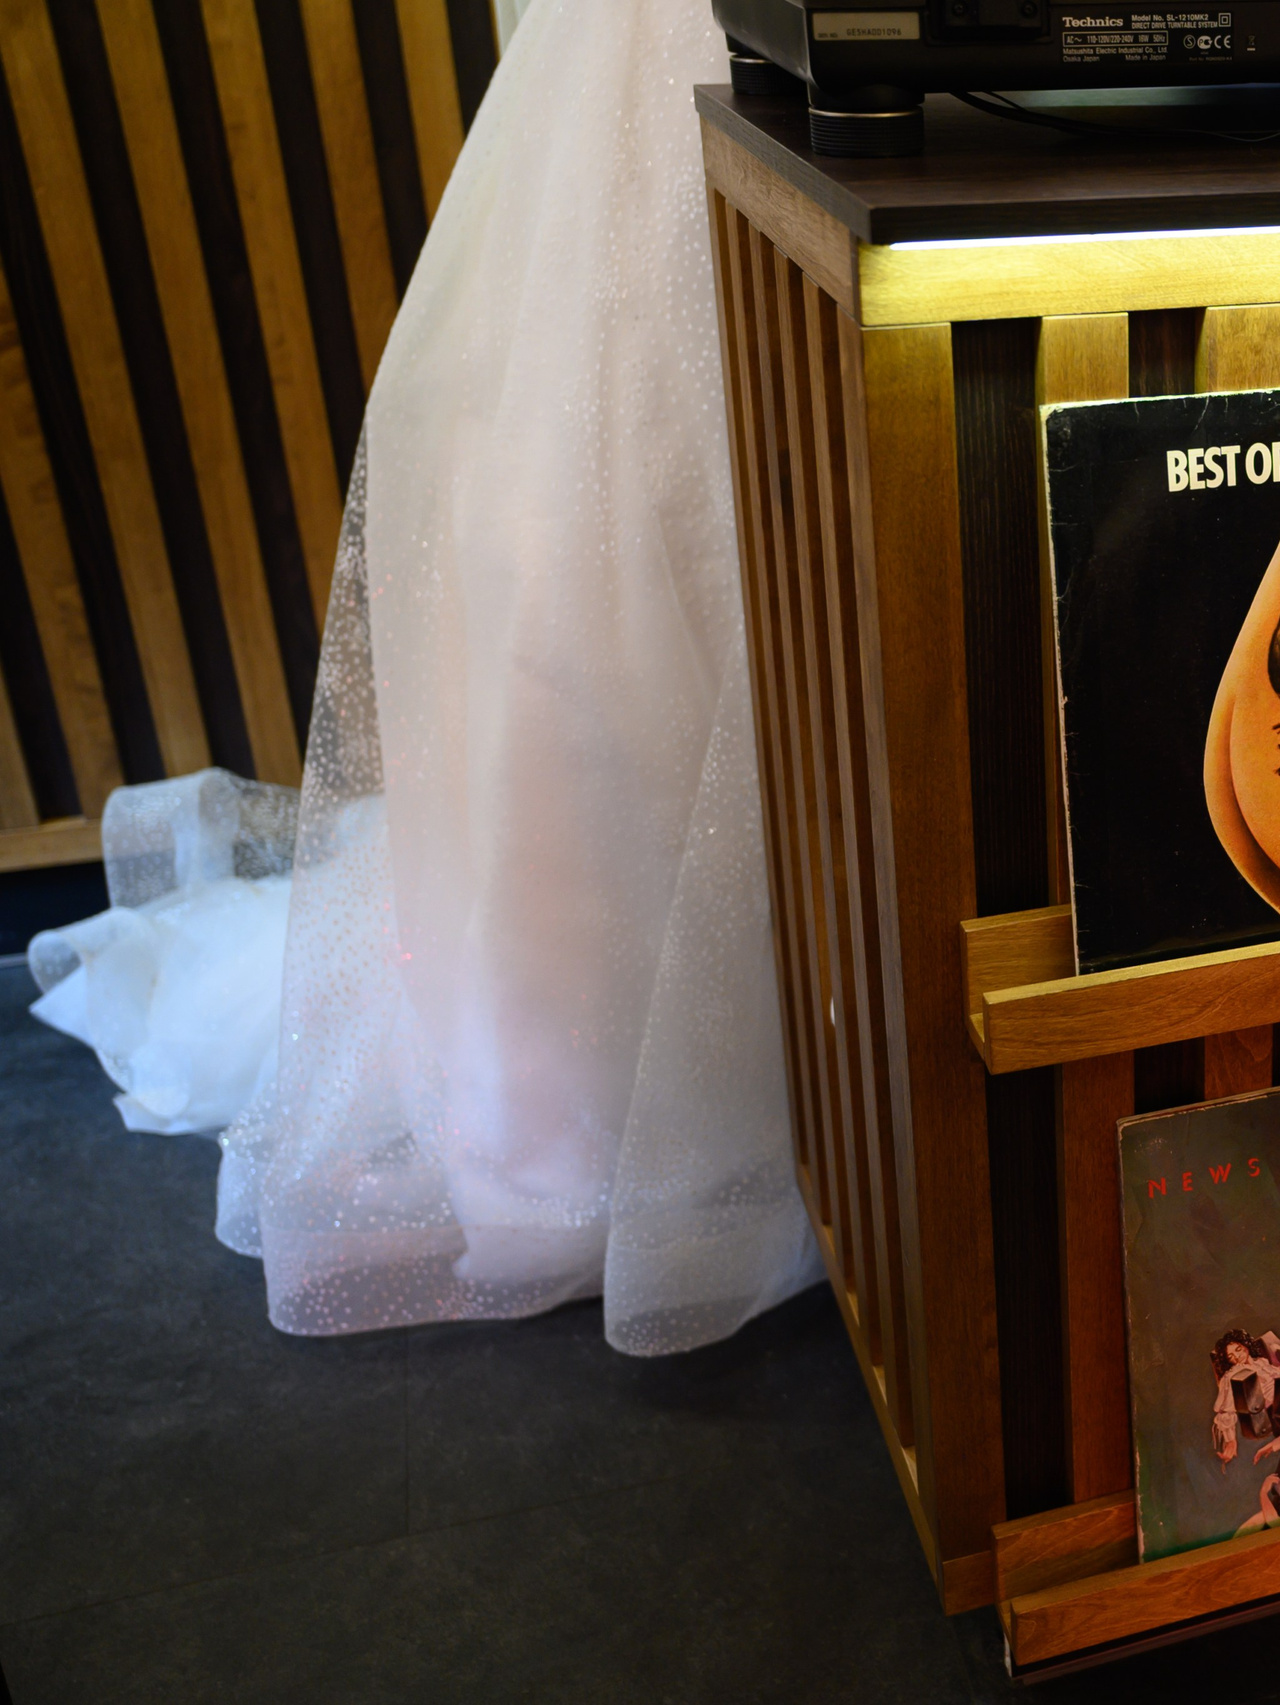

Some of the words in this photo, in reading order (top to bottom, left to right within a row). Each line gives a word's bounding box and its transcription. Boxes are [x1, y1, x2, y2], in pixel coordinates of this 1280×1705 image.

[1062, 16, 1124, 27] Technics
[1166, 13, 1209, 21] SL-1210MK2
[1131, 21, 1150, 29] DIRECT
[1151, 21, 1167, 29] DRIVE
[1167, 21, 1197, 29] TURNTABLE
[1166, 444, 1241, 493] BEST
[1147, 1157, 1263, 1199] NEWS
